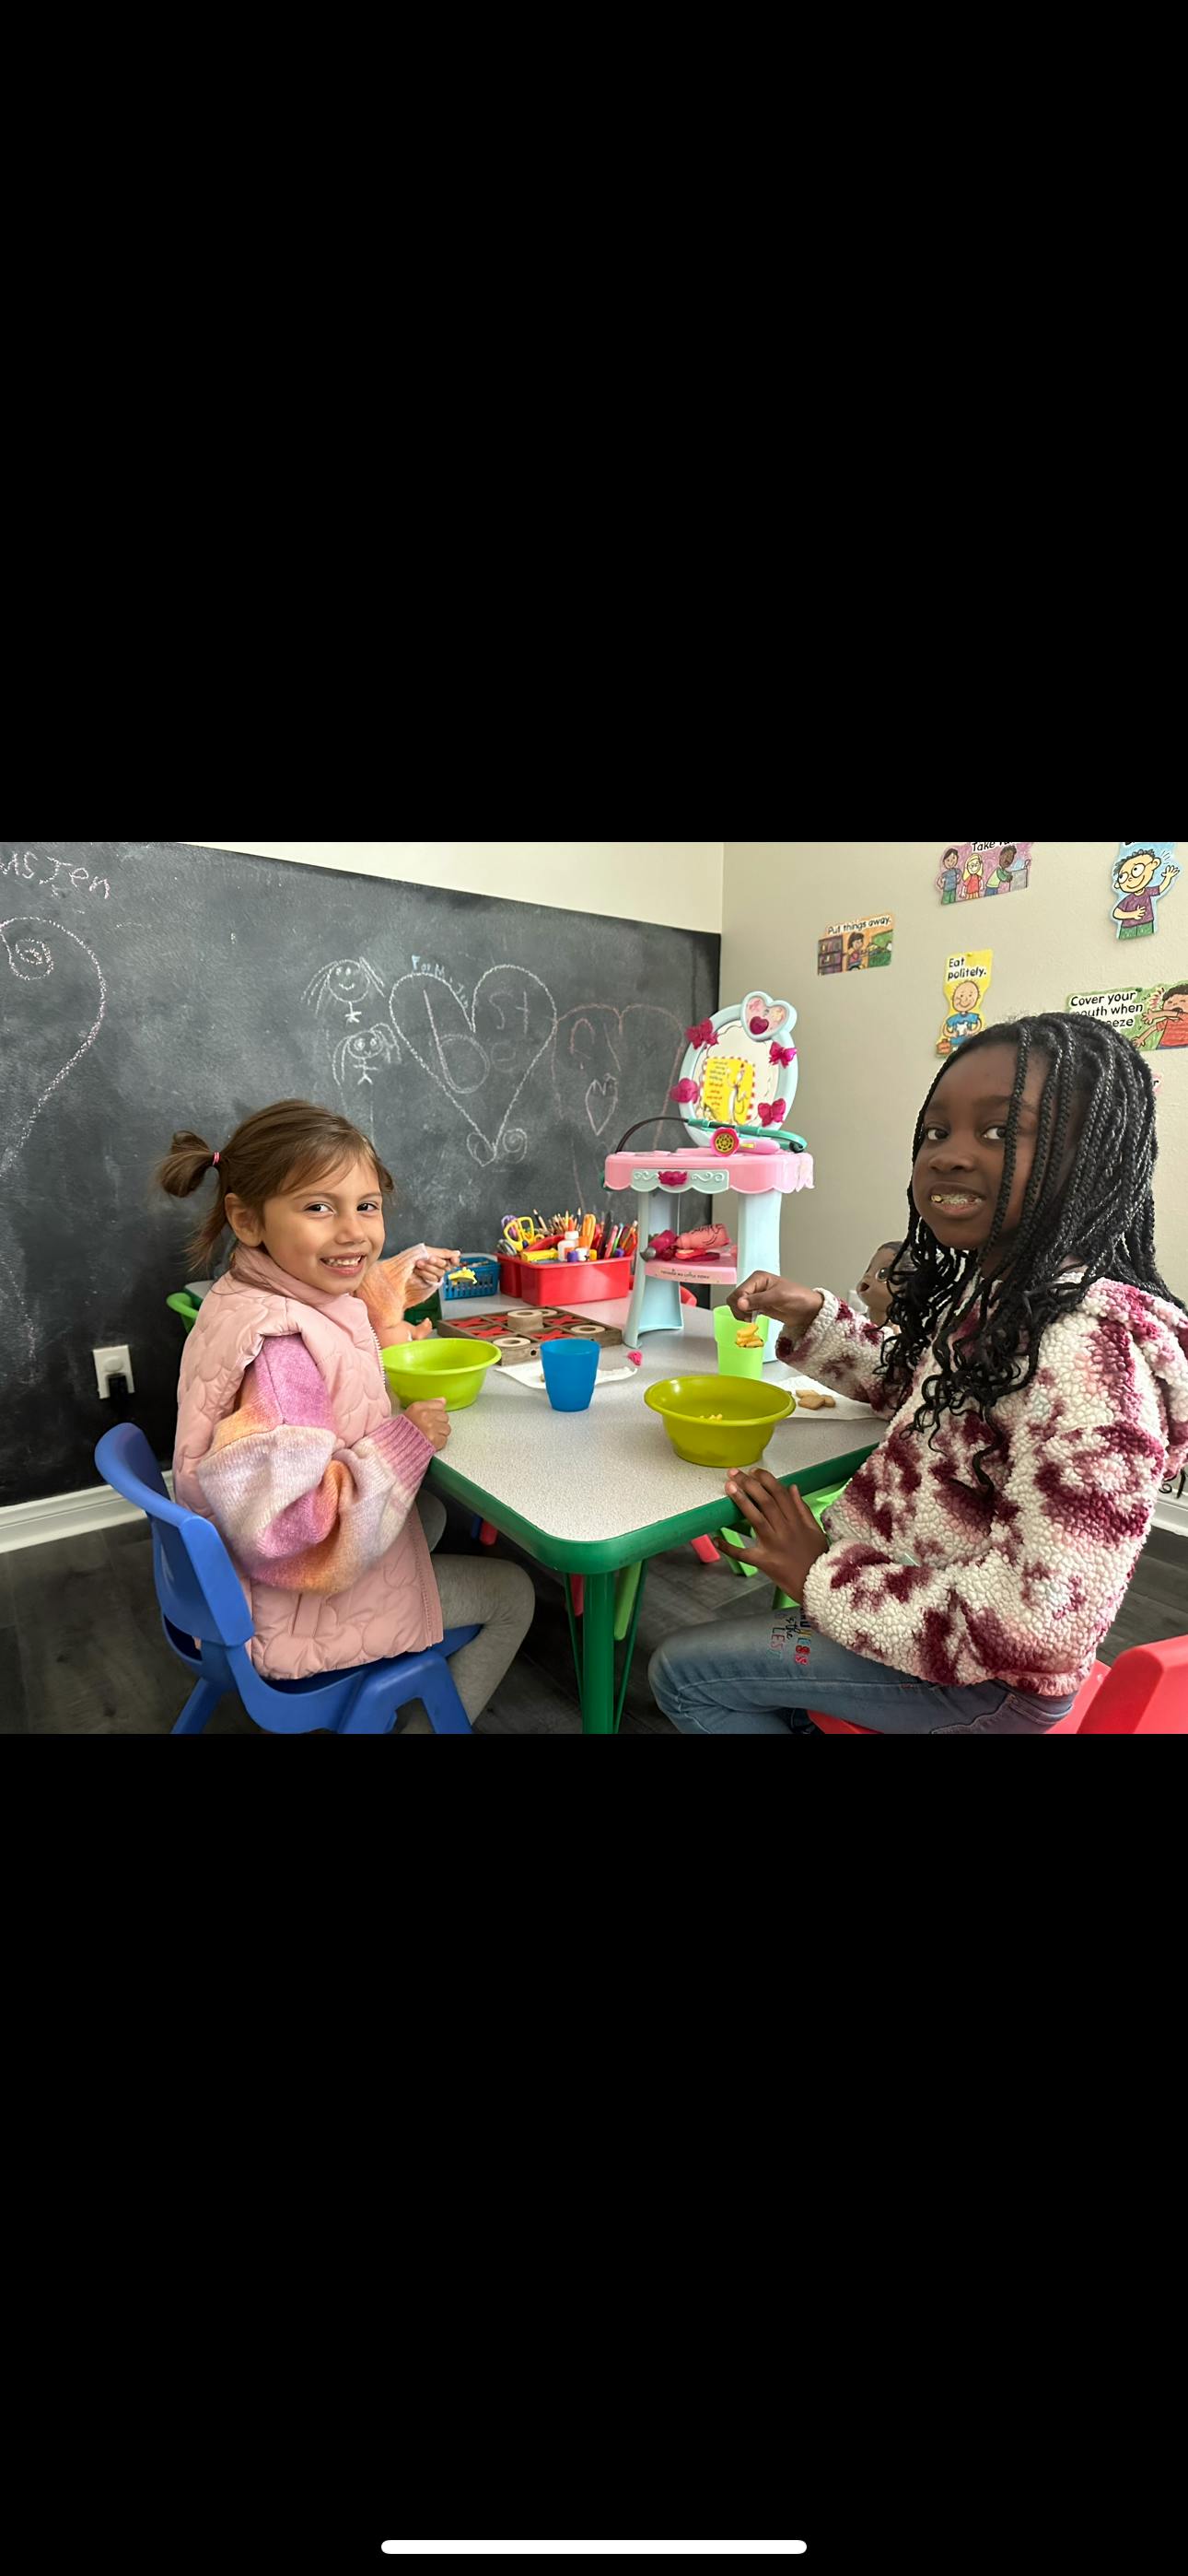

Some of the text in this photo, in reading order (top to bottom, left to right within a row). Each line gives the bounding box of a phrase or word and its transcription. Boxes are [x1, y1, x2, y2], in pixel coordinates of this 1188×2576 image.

[973, 841, 995, 852] Take
[827, 916, 891, 935] Put things away.
[949, 957, 965, 967] Eat
[947, 966, 986, 981] politely.
[1070, 991, 1136, 1006] Cover your
[1073, 1003, 1144, 1016] outh when
